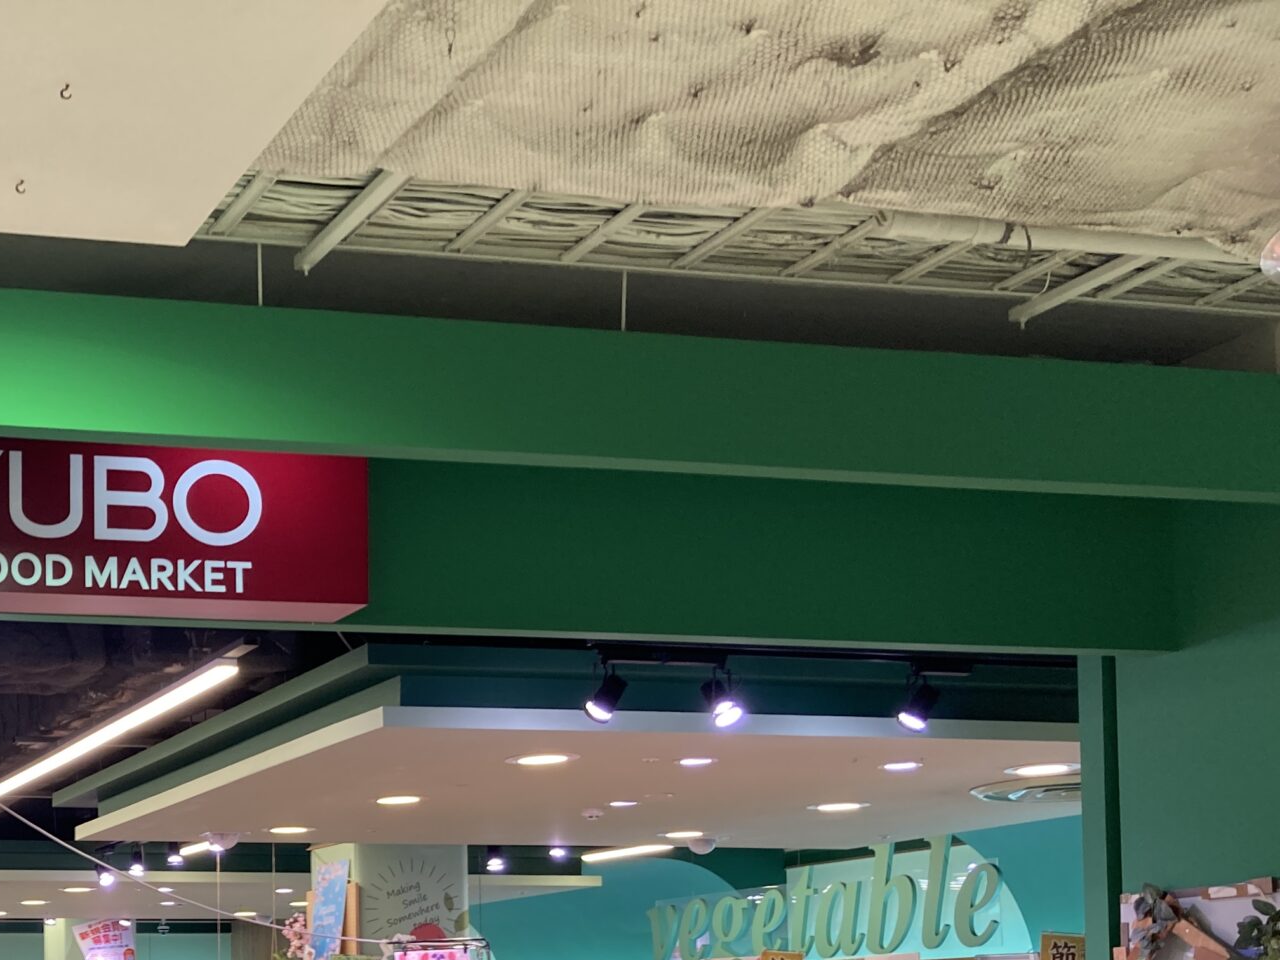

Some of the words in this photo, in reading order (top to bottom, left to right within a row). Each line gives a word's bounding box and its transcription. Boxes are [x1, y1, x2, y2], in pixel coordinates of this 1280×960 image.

[84, 556, 252, 594] MARKET
[386, 881, 420, 899] Making
[402, 894, 428, 909] Smile
[386, 902, 440, 928] Somewhere
